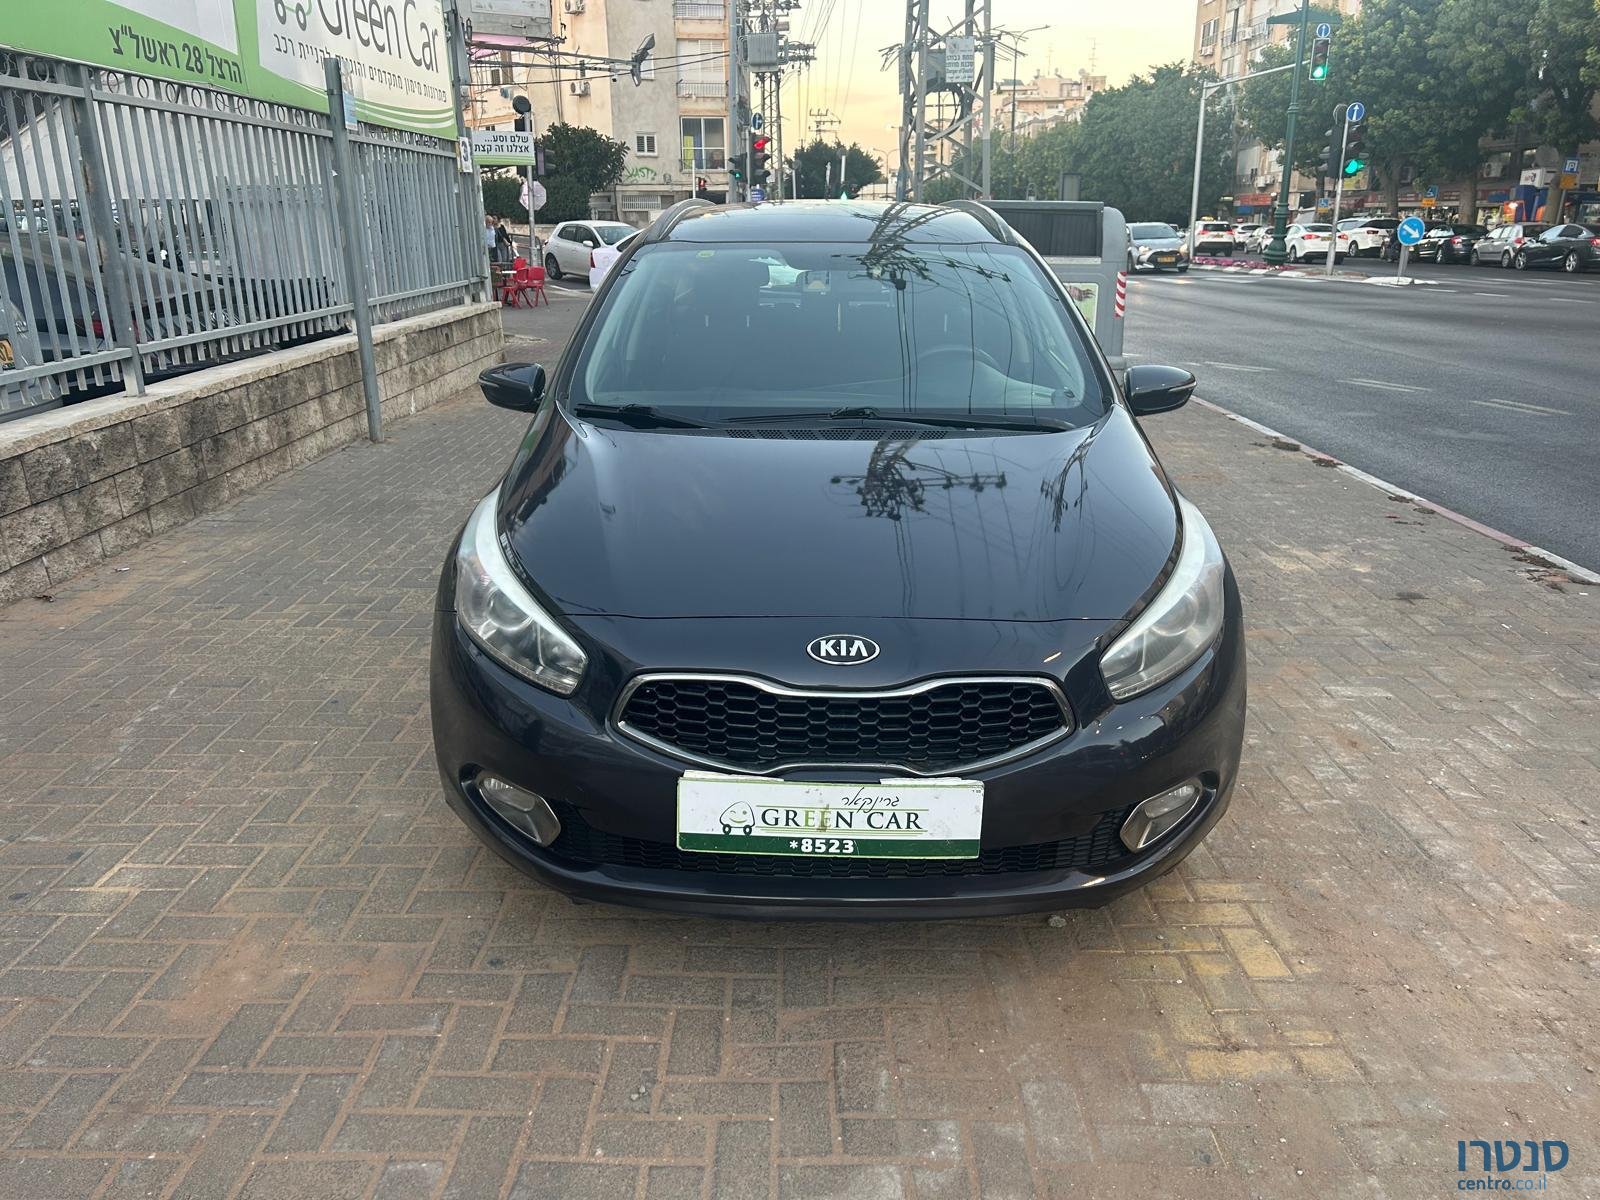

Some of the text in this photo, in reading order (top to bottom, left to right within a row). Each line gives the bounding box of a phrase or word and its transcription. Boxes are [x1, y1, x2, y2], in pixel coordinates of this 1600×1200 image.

[273, 33, 296, 57] רכב
[403, 0, 439, 73] Car
[108, 24, 242, 83] הרצל 28 ראשל"צ
[368, 65, 403, 90] מתקדמים
[474, 143, 530, 154] אצלנו זה קצת
[510, 134, 529, 143] שלם
[819, 639, 869, 657] KIA
[841, 787, 900, 814] גרינקאר
[761, 808, 923, 830] GREEN CAR
